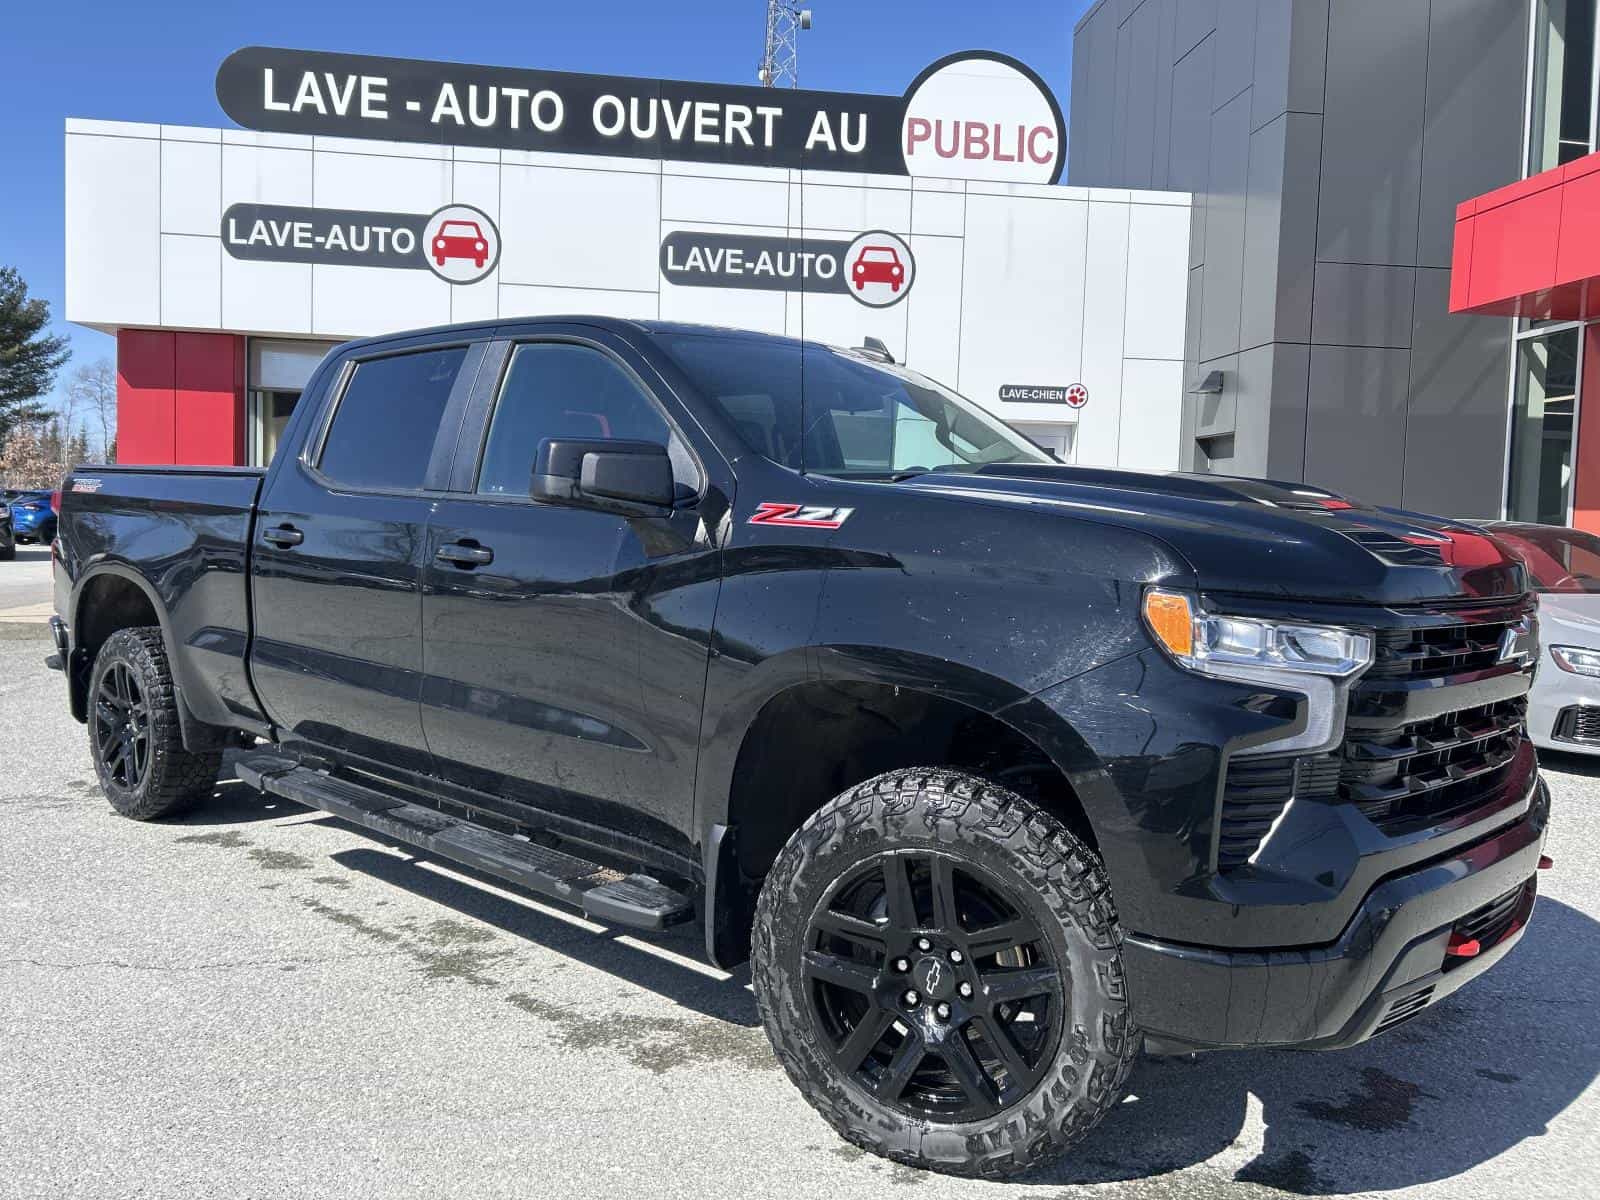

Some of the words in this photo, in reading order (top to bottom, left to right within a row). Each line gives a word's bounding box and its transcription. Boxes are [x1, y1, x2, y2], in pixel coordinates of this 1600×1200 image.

[263, 68, 389, 119] LAVE
[431, 82, 564, 132] AUTO
[592, 94, 783, 147] OUVERT
[805, 111, 868, 153] AU
[906, 117, 1055, 164] PUBLIC
[228, 218, 415, 254] LAVE-AUTO
[666, 245, 837, 279] LAVE-AUTO
[1001, 388, 1064, 400] LAVE-CHIEN
[746, 502, 856, 529] Z71
